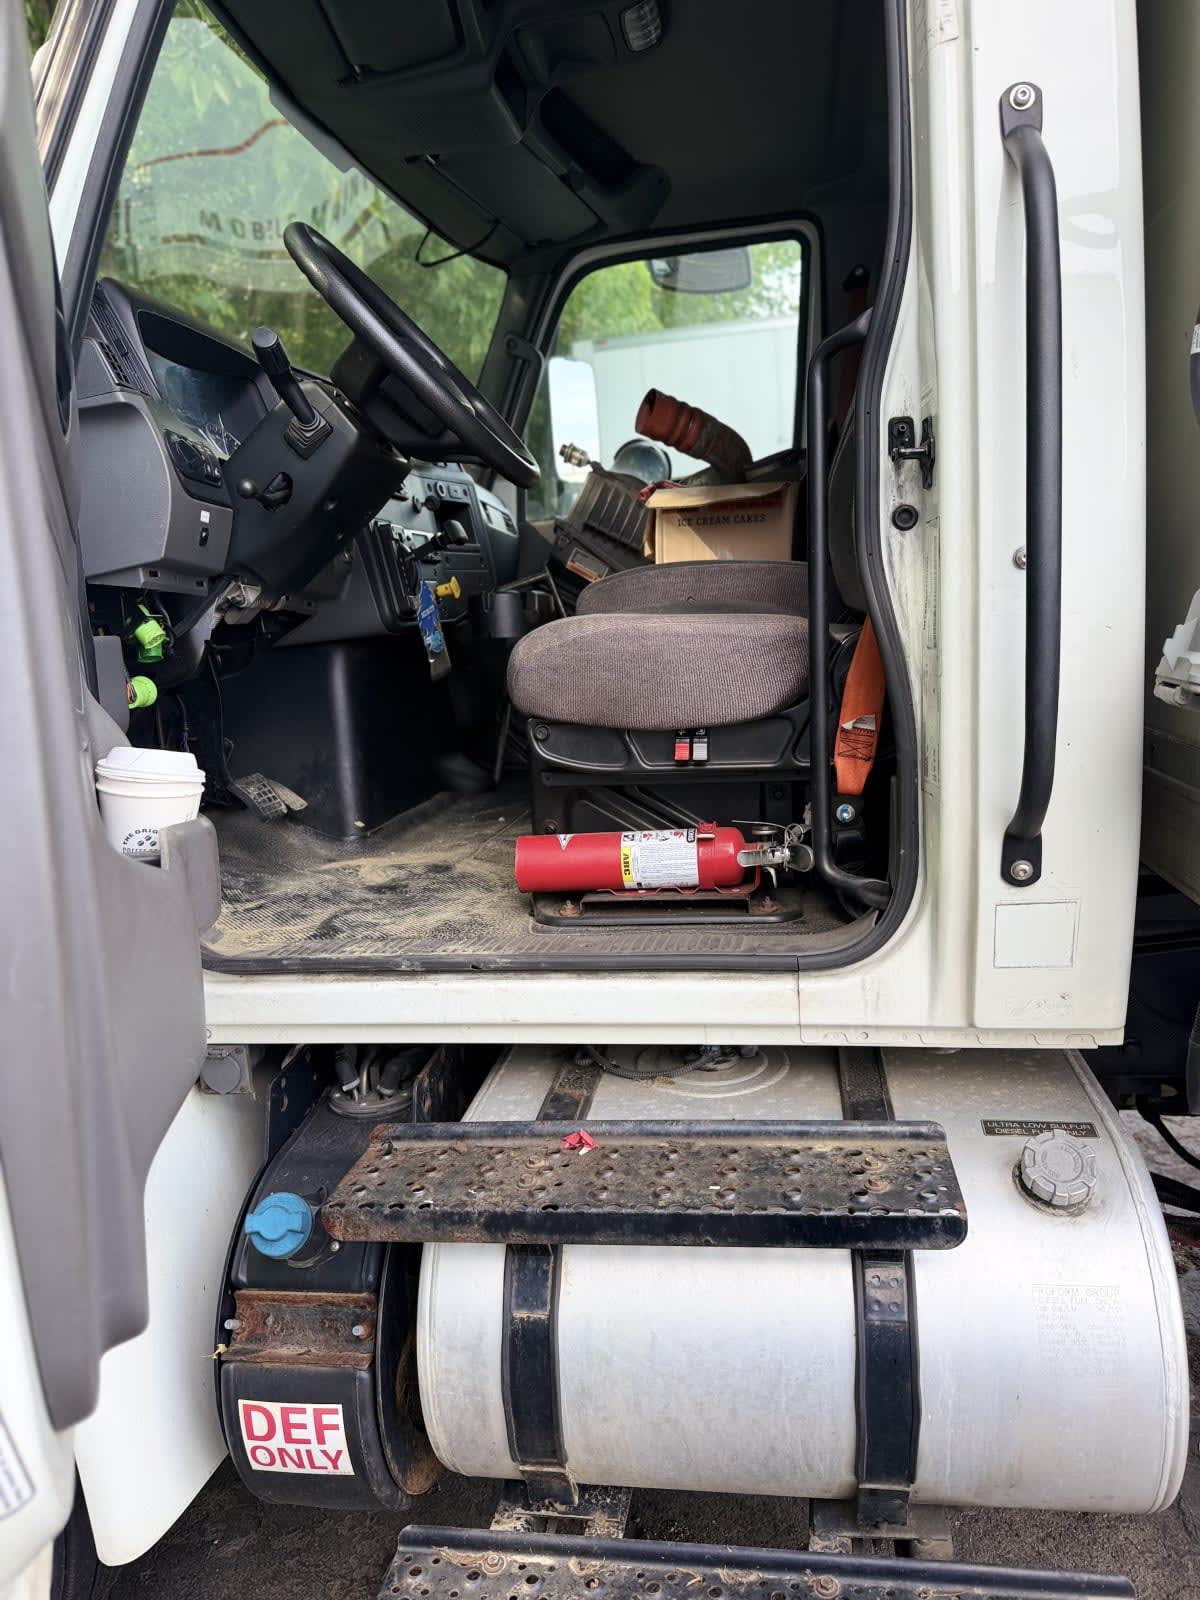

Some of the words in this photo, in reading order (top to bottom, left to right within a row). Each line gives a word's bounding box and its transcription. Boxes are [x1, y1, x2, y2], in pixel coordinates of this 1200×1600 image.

[678, 518, 692, 527] ICE
[696, 515, 730, 526] CREAM
[734, 513, 768, 523] CAKES
[623, 853, 631, 876] ABC
[242, 1404, 340, 1445] DEF
[250, 1445, 343, 1470] ONLY
